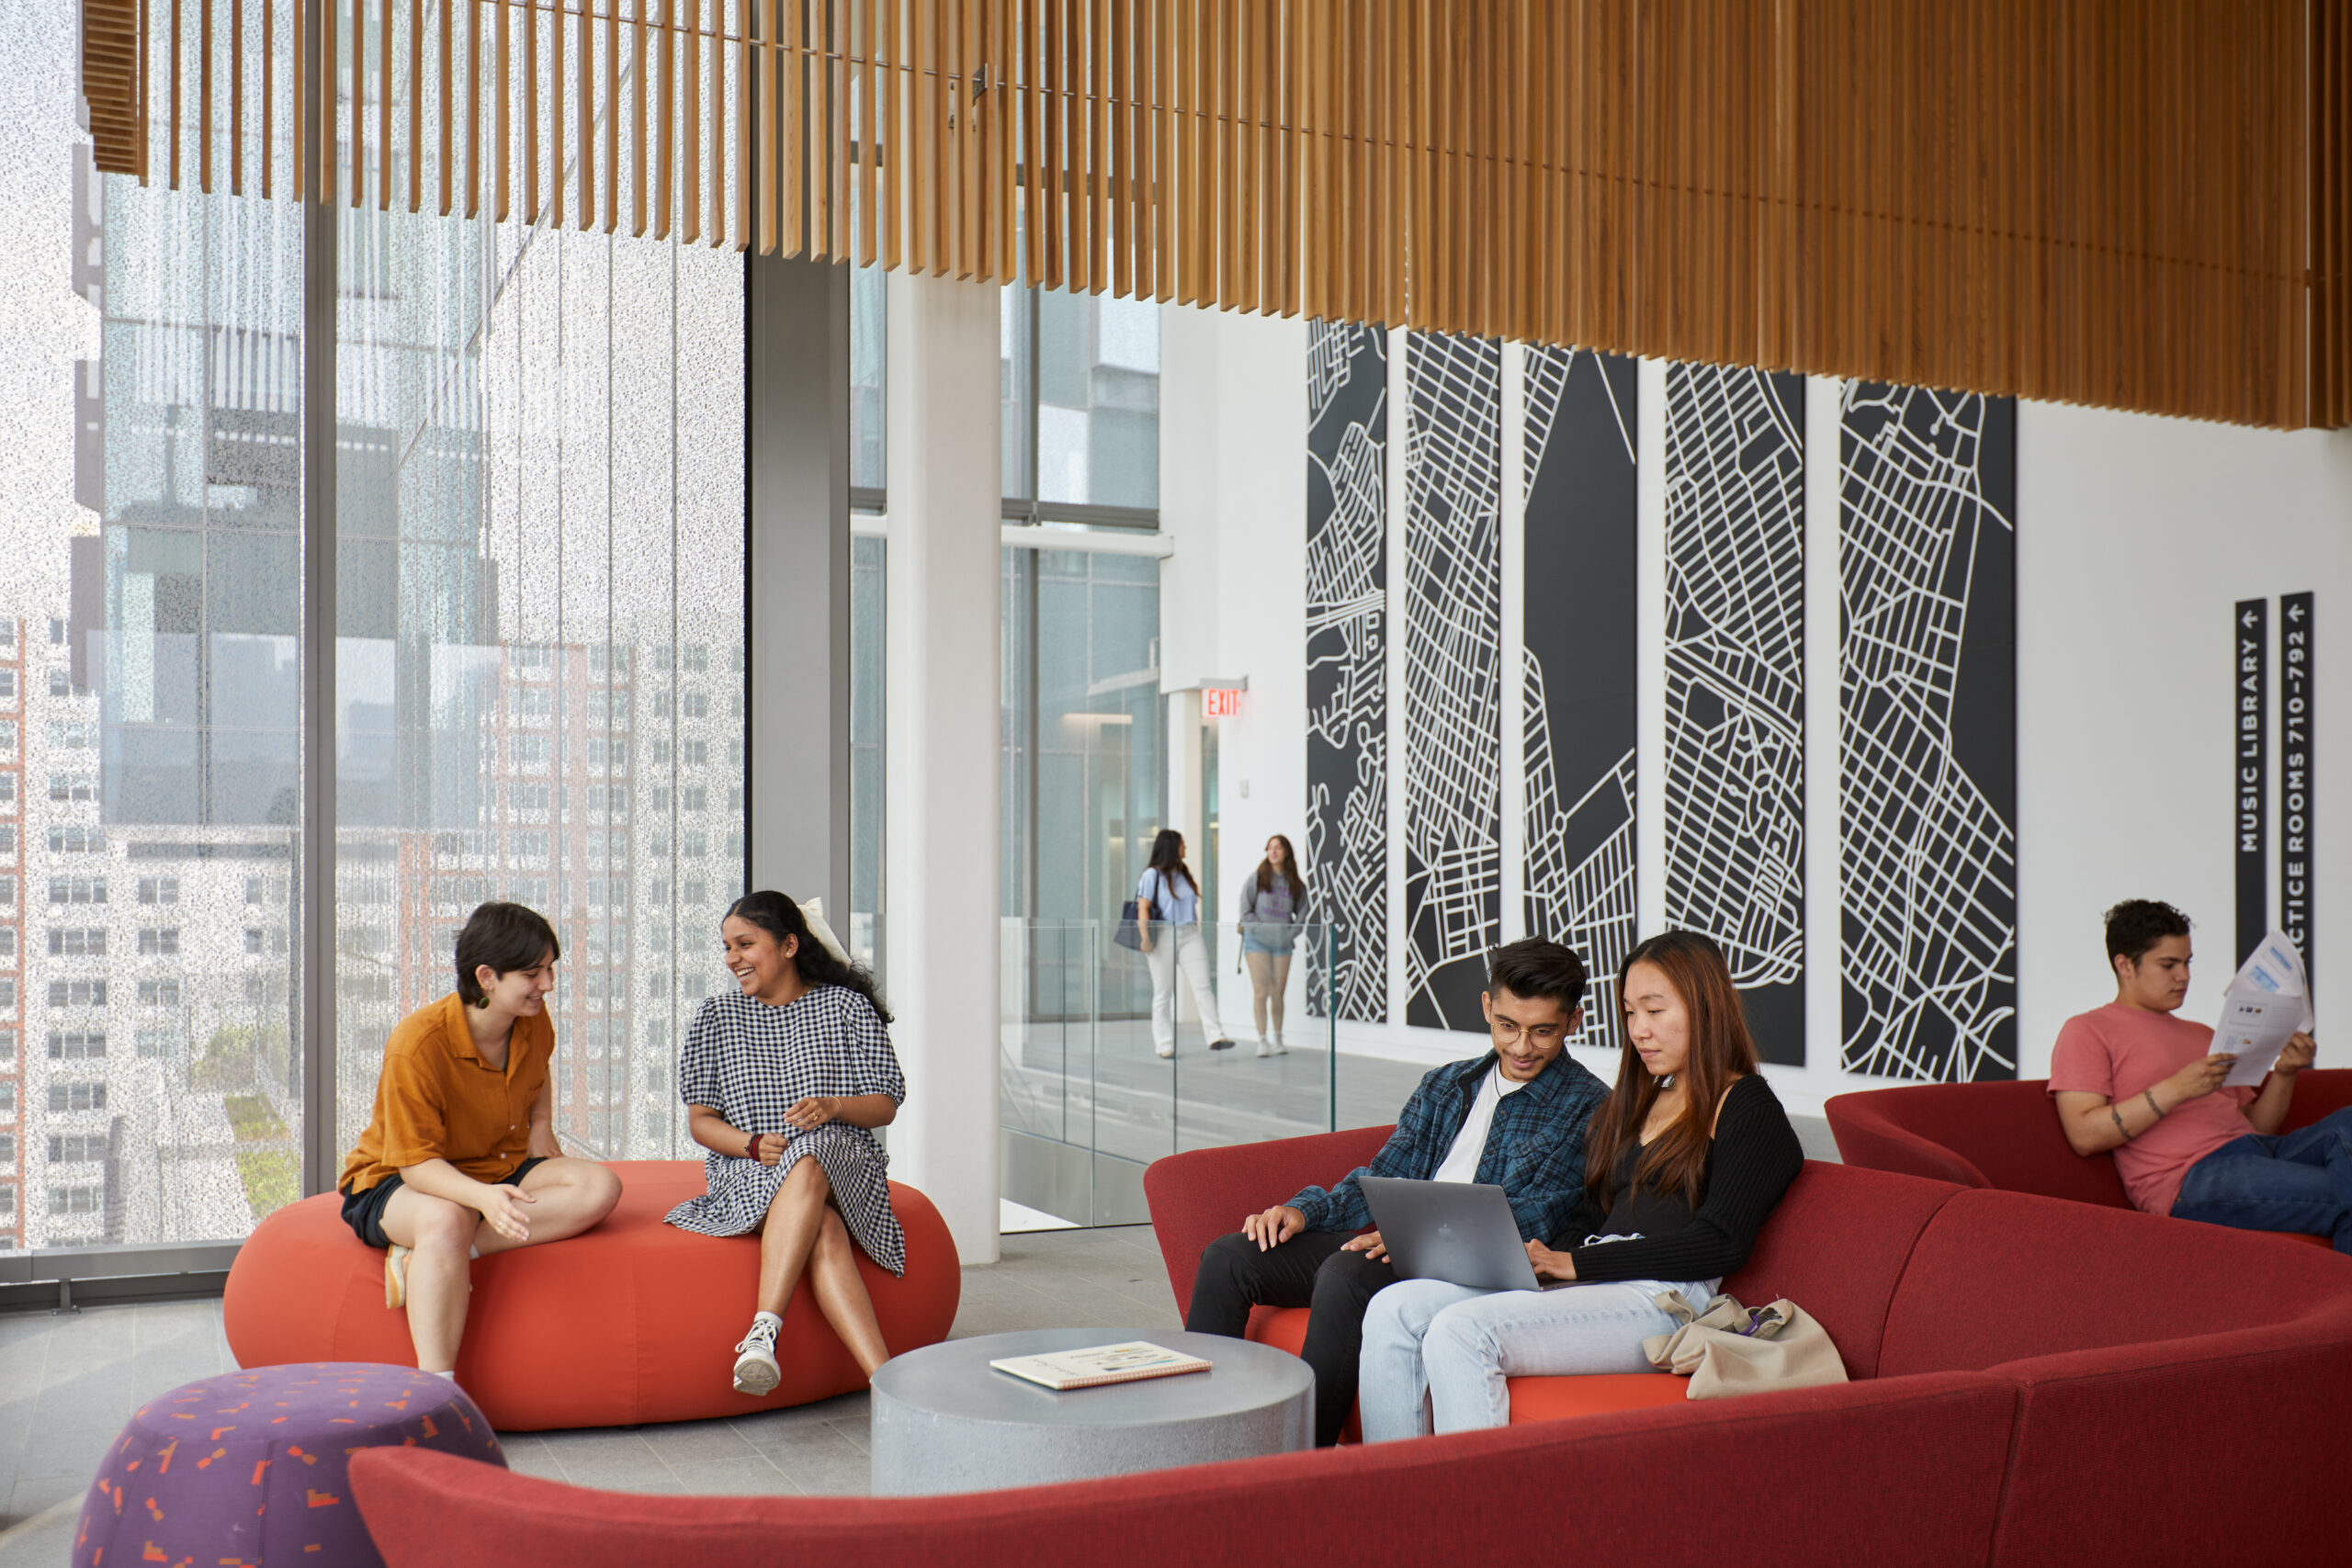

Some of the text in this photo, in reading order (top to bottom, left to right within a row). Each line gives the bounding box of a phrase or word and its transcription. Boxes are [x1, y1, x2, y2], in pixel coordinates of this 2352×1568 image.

[1208, 689, 1238, 716] EXIT
[2242, 638, 2257, 852] MUSIC LIBRARY
[2288, 630, 2304, 955] CTICE ROOMS 710-792
